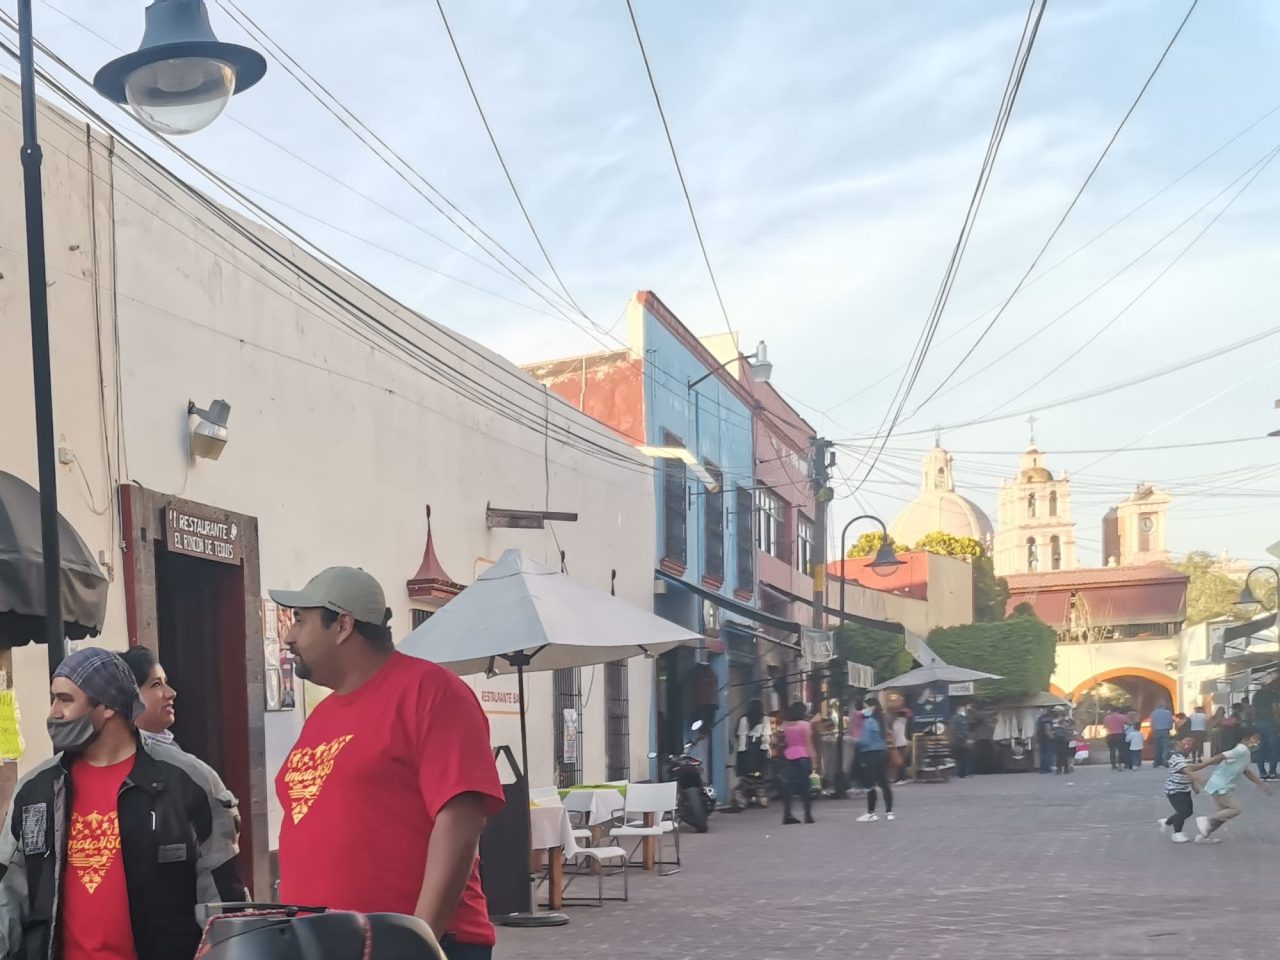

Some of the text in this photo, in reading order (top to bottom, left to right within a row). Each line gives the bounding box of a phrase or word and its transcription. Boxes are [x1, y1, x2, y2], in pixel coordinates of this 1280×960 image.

[179, 514, 228, 539] RESTAURANTE
[174, 532, 183, 549] EL
[482, 690, 512, 704] RESTAURANTE
